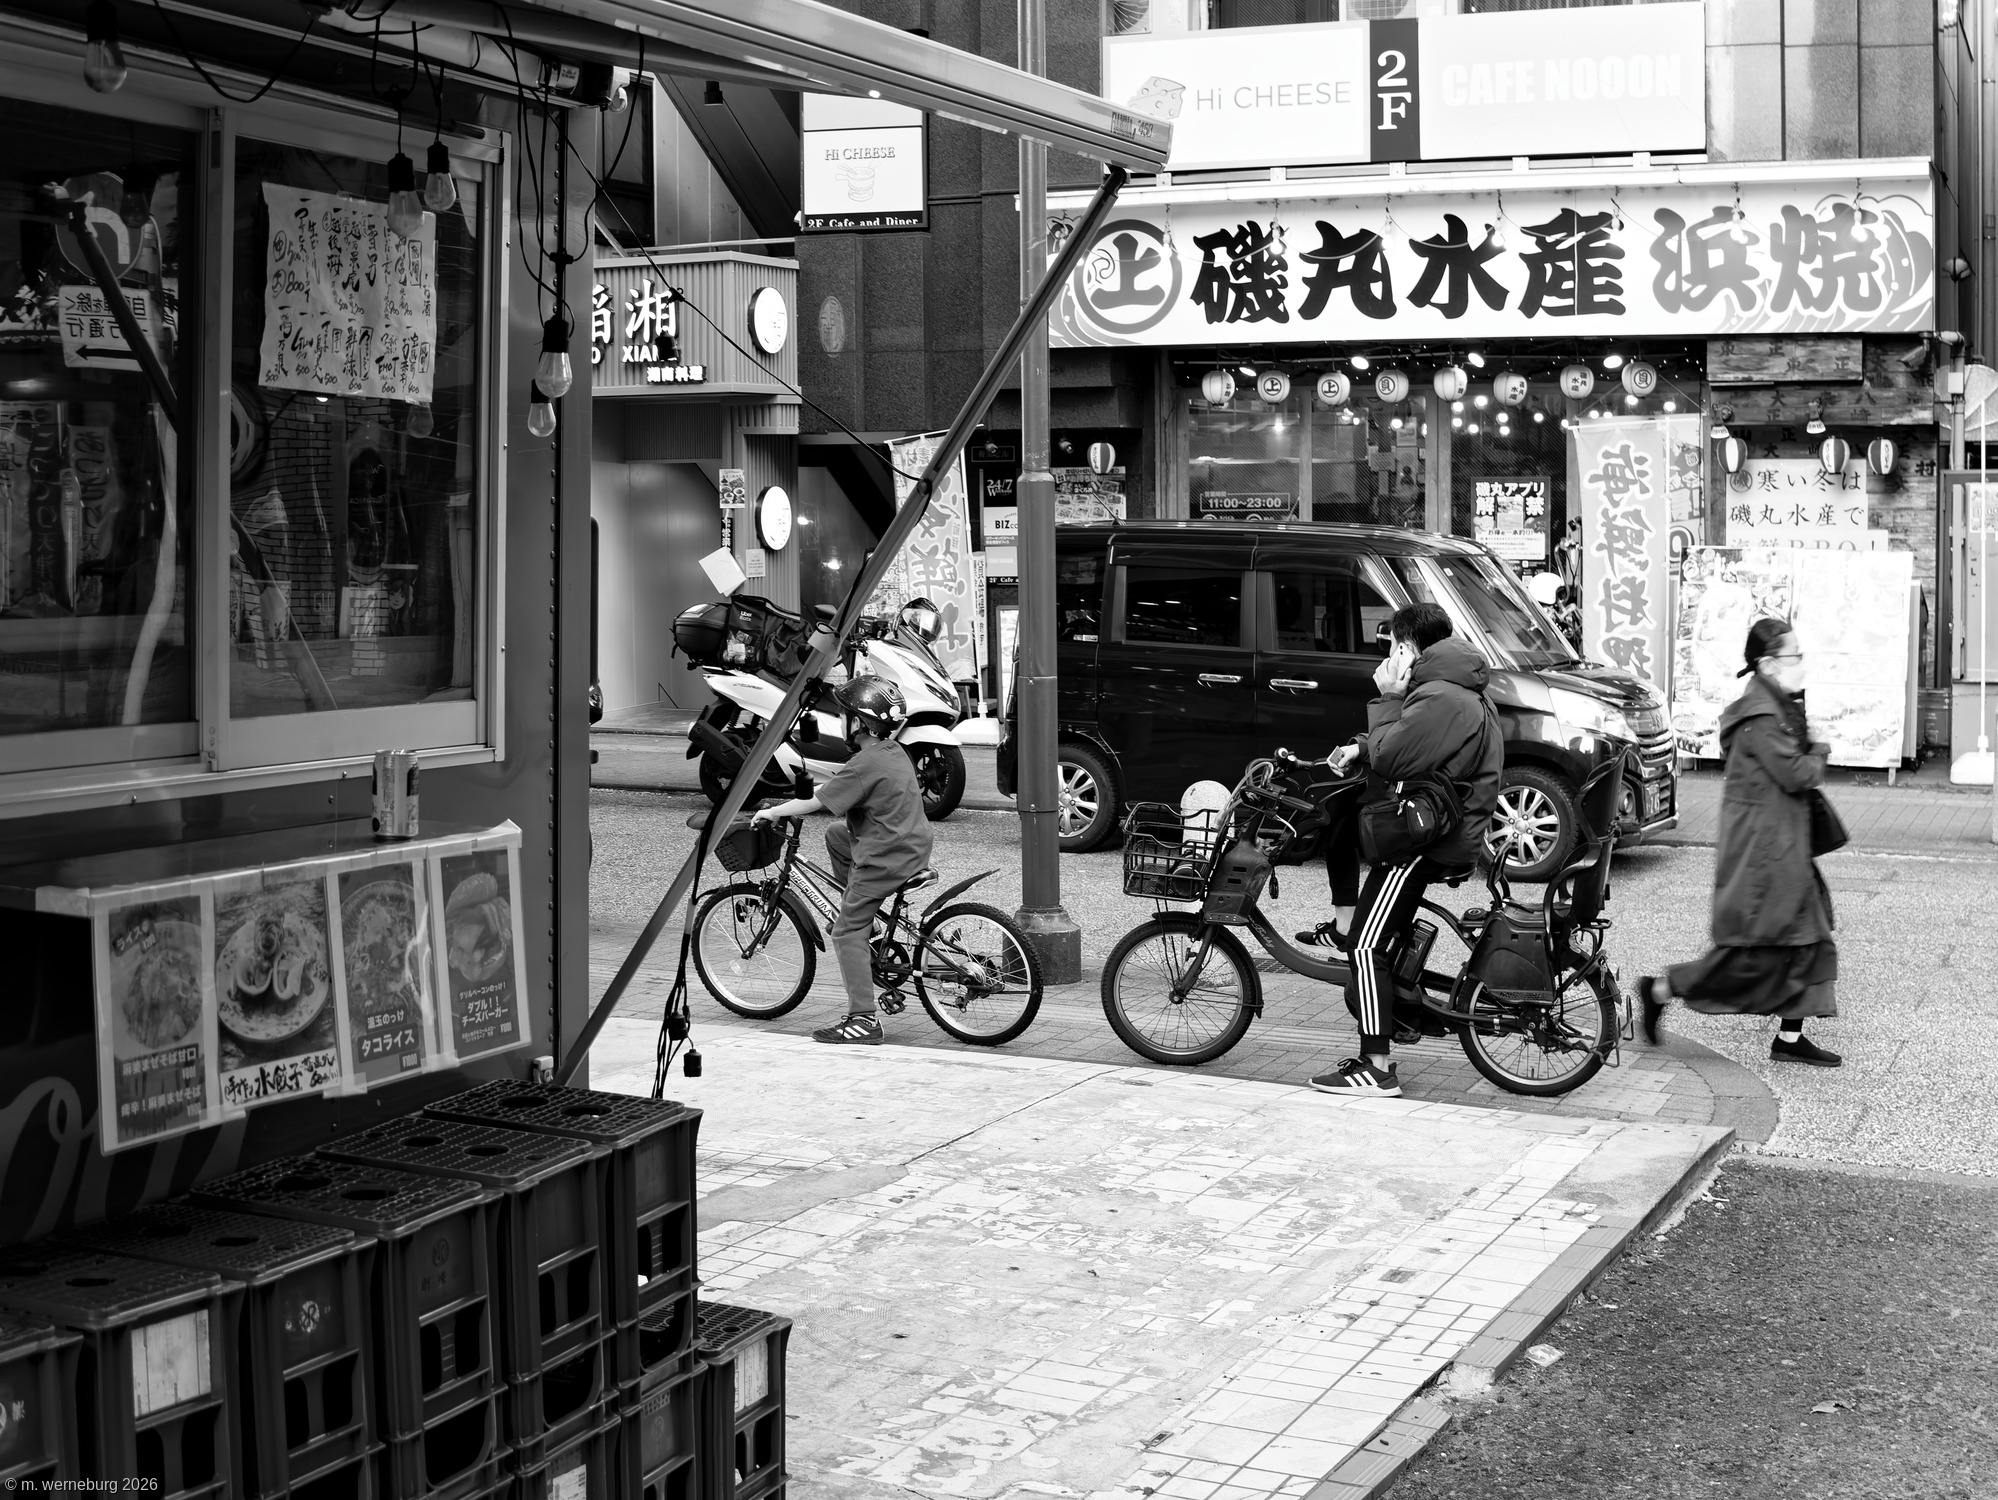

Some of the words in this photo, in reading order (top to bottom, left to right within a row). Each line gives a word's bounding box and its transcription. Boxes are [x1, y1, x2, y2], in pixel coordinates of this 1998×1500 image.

[1442, 62, 1536, 107] CAFE
[1543, 53, 1682, 102] NOOON
[1196, 87, 1223, 111] Hi
[1234, 81, 1352, 109] CHEESE
[825, 149, 840, 161] Hi
[843, 147, 896, 160] CHEESE
[807, 219, 824, 228] 2F
[828, 218, 855, 228] Cafe
[859, 217, 881, 227] and
[885, 216, 919, 227] Diner
[1191, 212, 1626, 324] 磯丸水産
[1650, 203, 1882, 314] 浜焼
[1267, 379, 1280, 393] 上
[1325, 382, 1337, 395] 上
[987, 479, 1013, 490] 24/7
[1475, 481, 1545, 497] 磯丸アプリ
[1758, 468, 1861, 492] 寒い冬は
[1526, 496, 1545, 516] 禁
[1729, 503, 1865, 527] 磯丸水産で
[116, 927, 142, 951] ライス
[367, 1009, 405, 1030] 温玉のっけ
[461, 1005, 509, 1028] チーズバーガー
[361, 1029, 415, 1057] タコライス
